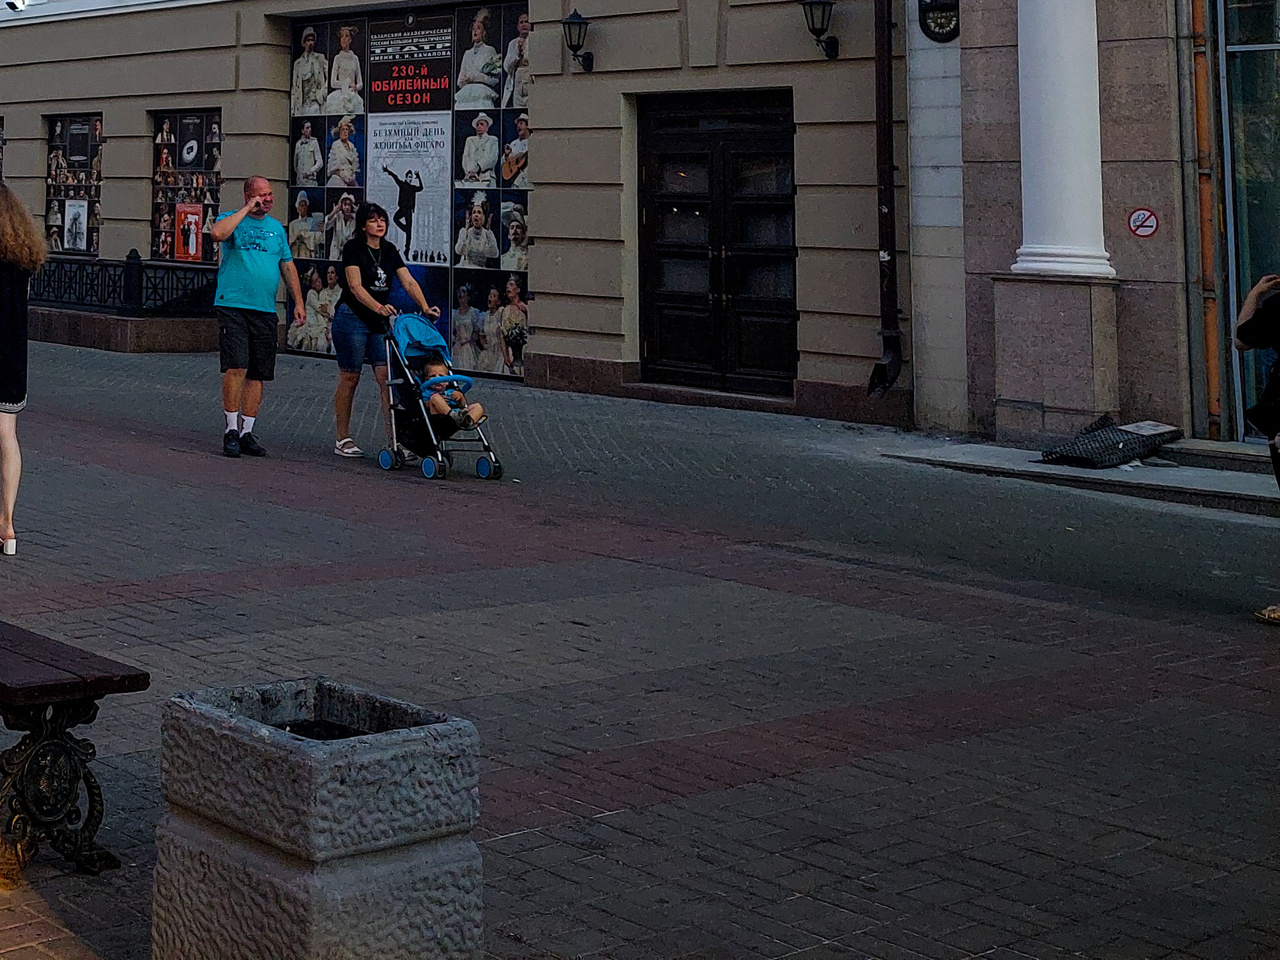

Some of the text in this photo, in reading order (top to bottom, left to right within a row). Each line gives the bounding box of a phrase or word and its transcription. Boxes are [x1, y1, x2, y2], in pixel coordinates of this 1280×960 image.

[371, 43, 451, 53] ТЕАТР
[371, 76, 449, 93] ЮБИЛЕЙНЫЙ
[387, 92, 430, 105] СЕЗОН
[373, 126, 445, 137] БЕЗУМНЫЙ ДЕНЬ
[373, 140, 445, 150] ЖЕНИТЬБА ФИГАРО
